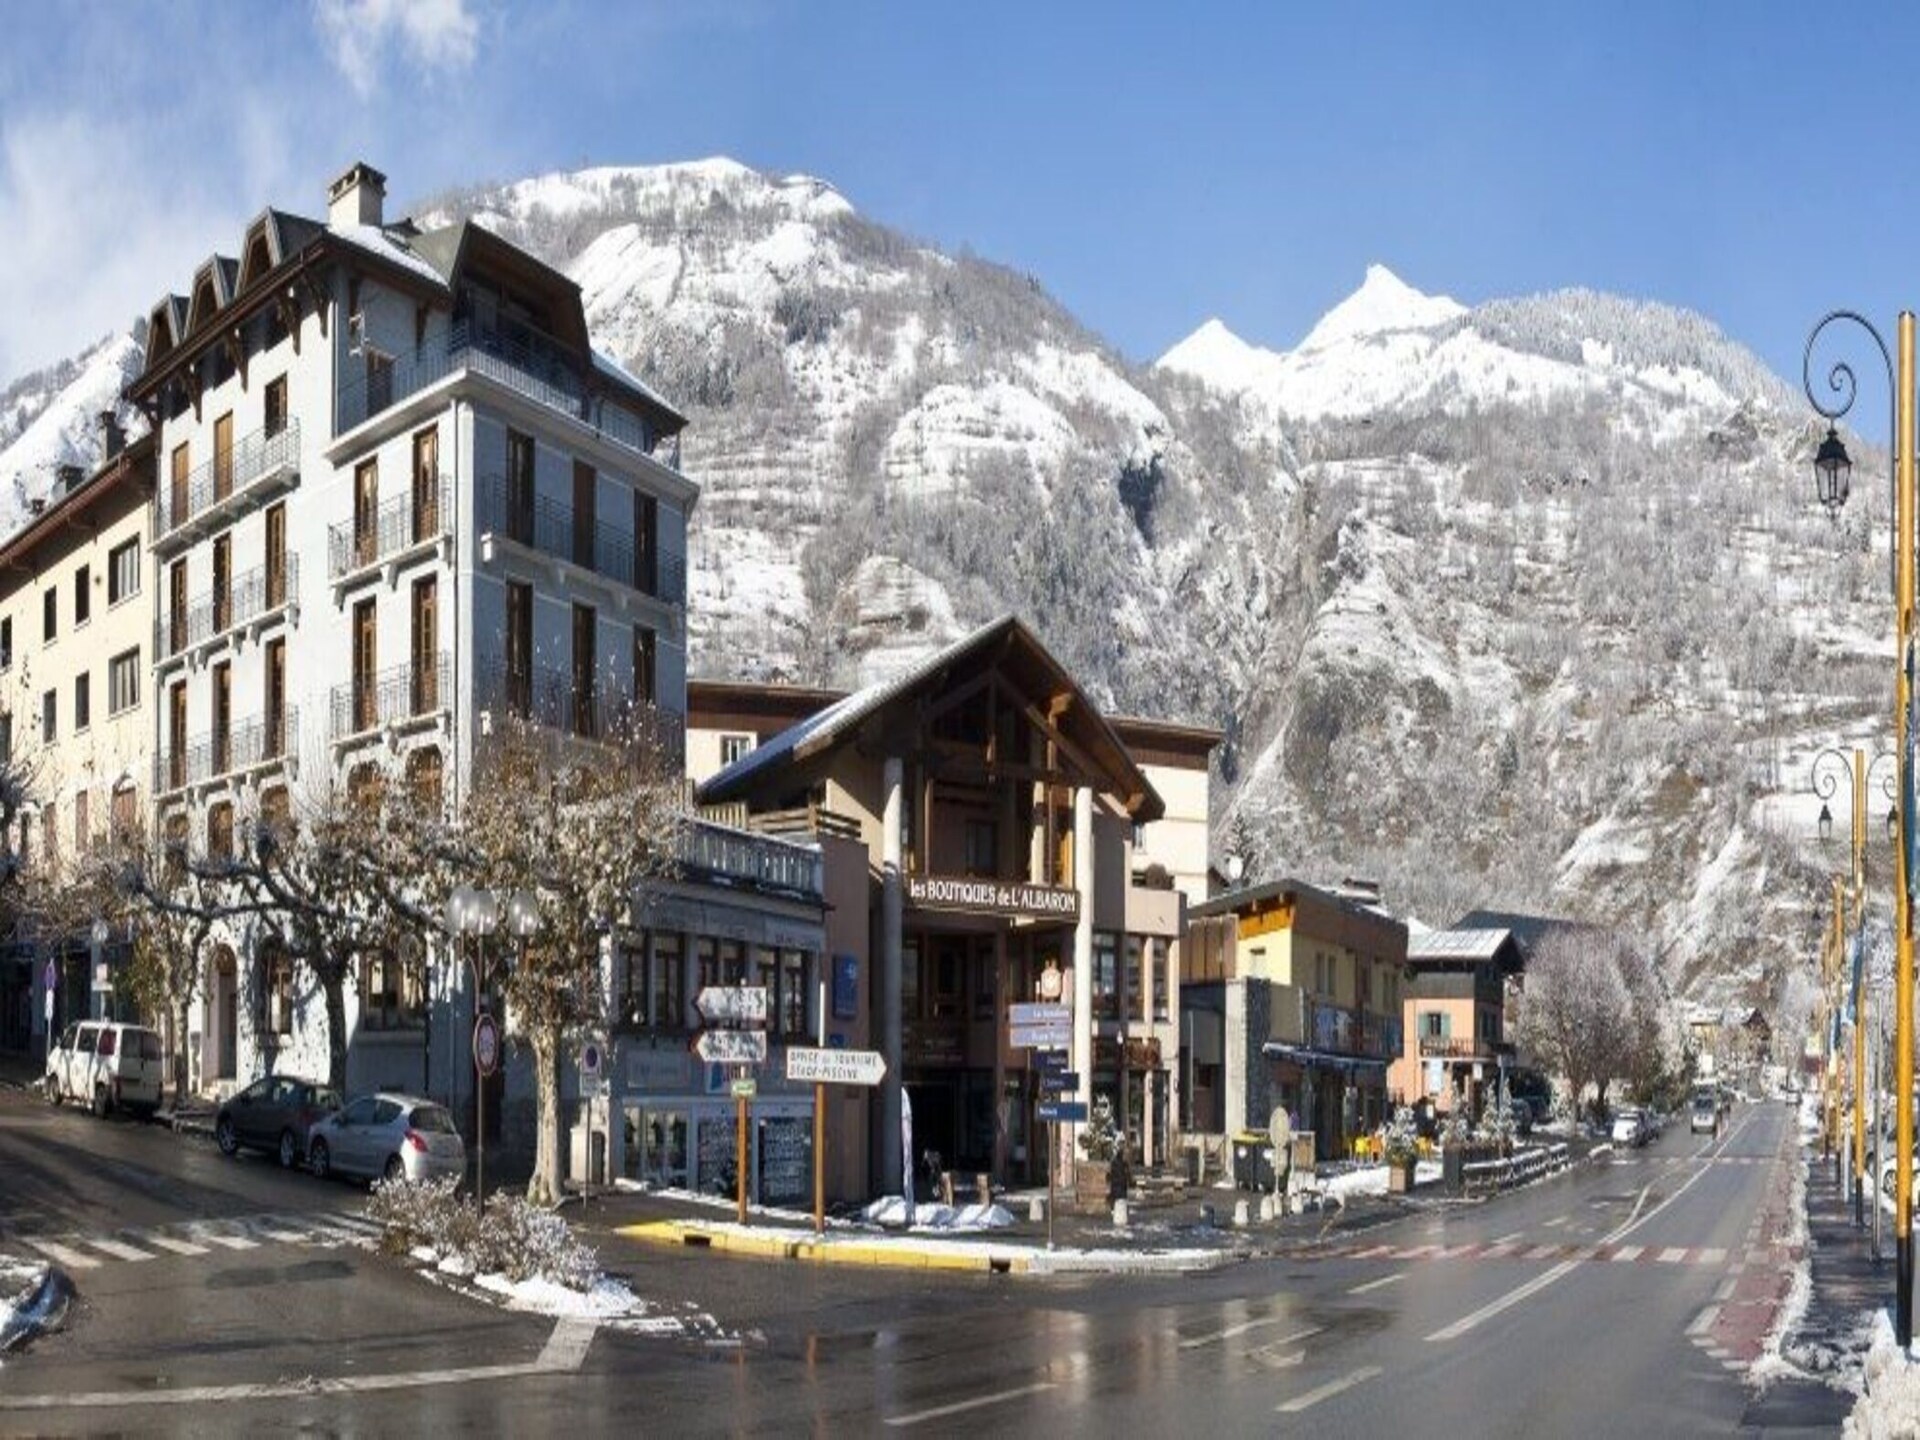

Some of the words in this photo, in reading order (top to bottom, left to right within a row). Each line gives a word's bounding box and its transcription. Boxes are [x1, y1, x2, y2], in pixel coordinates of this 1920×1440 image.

[910, 878, 926, 898] les
[927, 880, 996, 906] BOUTIQUES
[997, 887, 1010, 906] de
[1011, 887, 1076, 912] L'ALBARON
